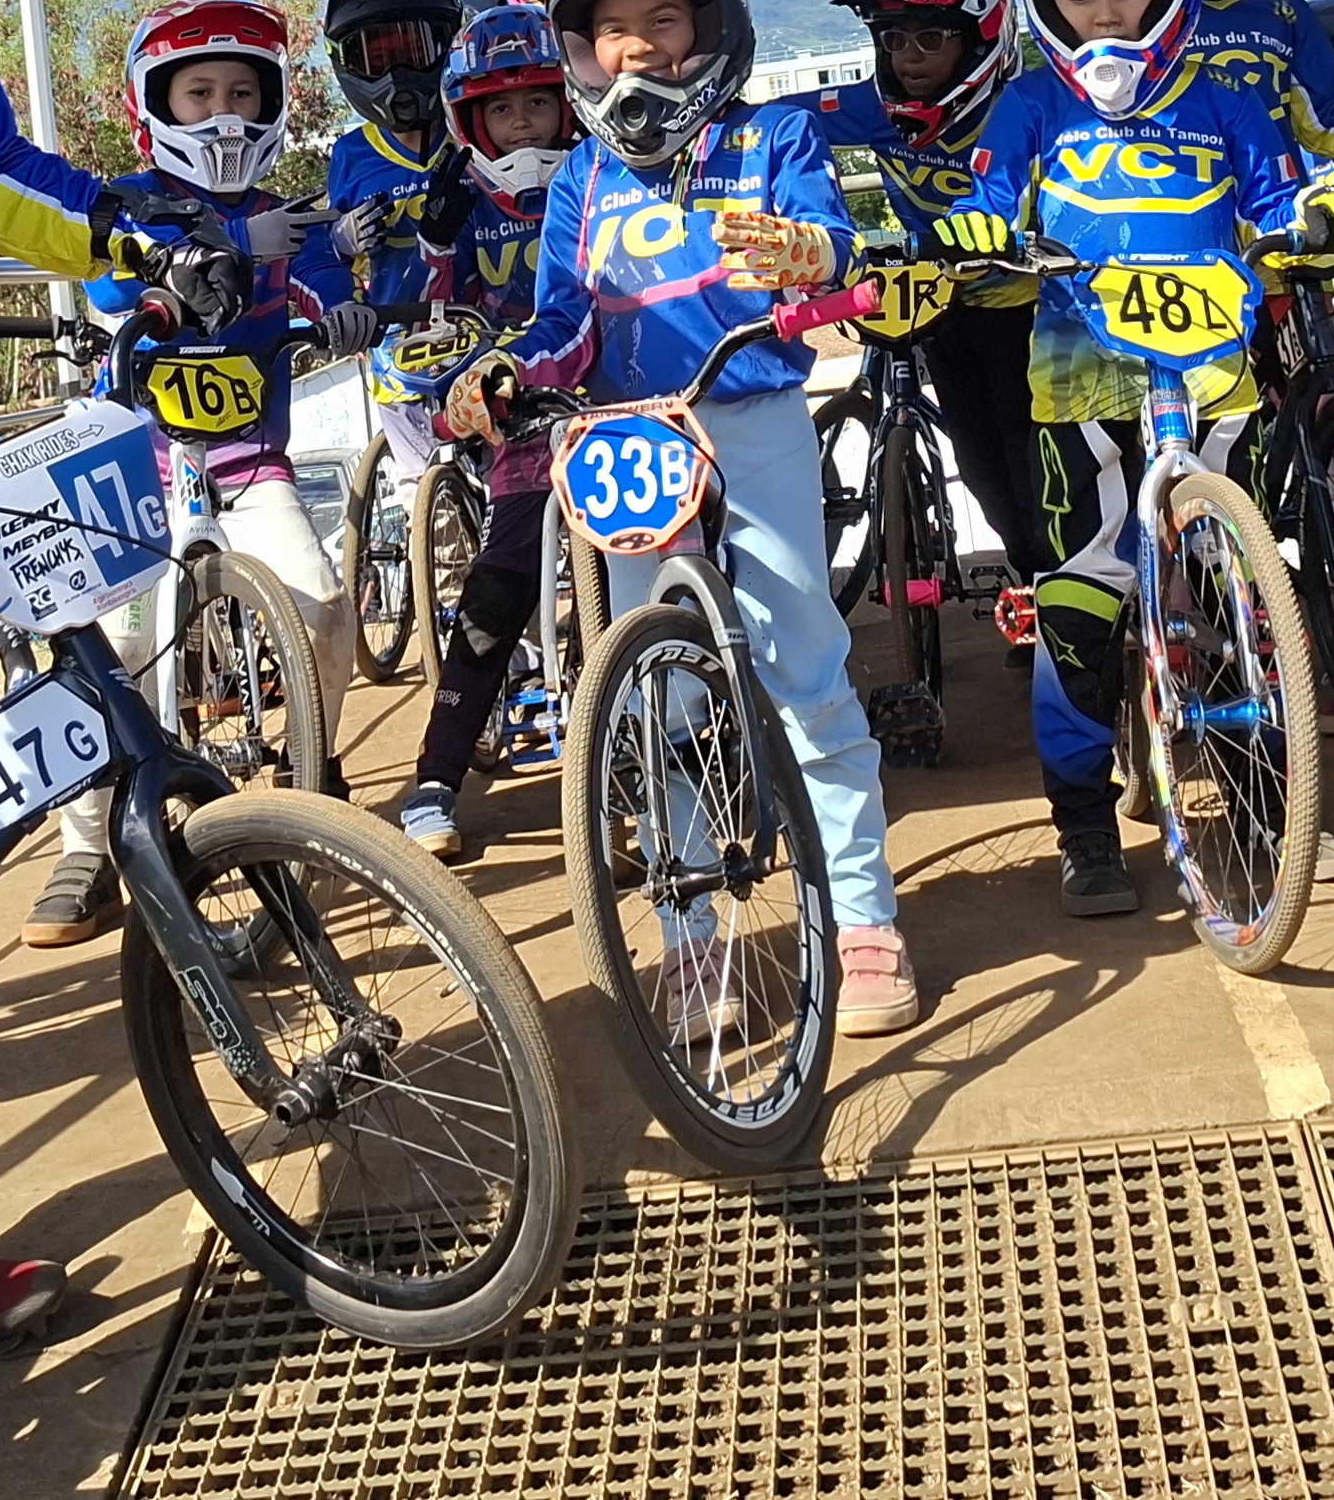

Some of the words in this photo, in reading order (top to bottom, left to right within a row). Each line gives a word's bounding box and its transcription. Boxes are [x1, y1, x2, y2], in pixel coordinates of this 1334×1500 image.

[1226, 31, 1247, 44] du
[678, 81, 717, 125] ONYX
[1096, 125, 1135, 139] Club
[1140, 126, 1161, 138] du
[918, 153, 946, 168] Club
[948, 156, 963, 169] du
[1058, 142, 1224, 183] VCT
[892, 157, 973, 197] VC
[601, 187, 643, 210] Club
[648, 182, 672, 199] du
[475, 224, 498, 240] élo
[499, 220, 536, 237] Club
[36, 428, 81, 462] RIDES
[584, 435, 690, 519] 33B
[189, 525, 216, 535] AVIAN
